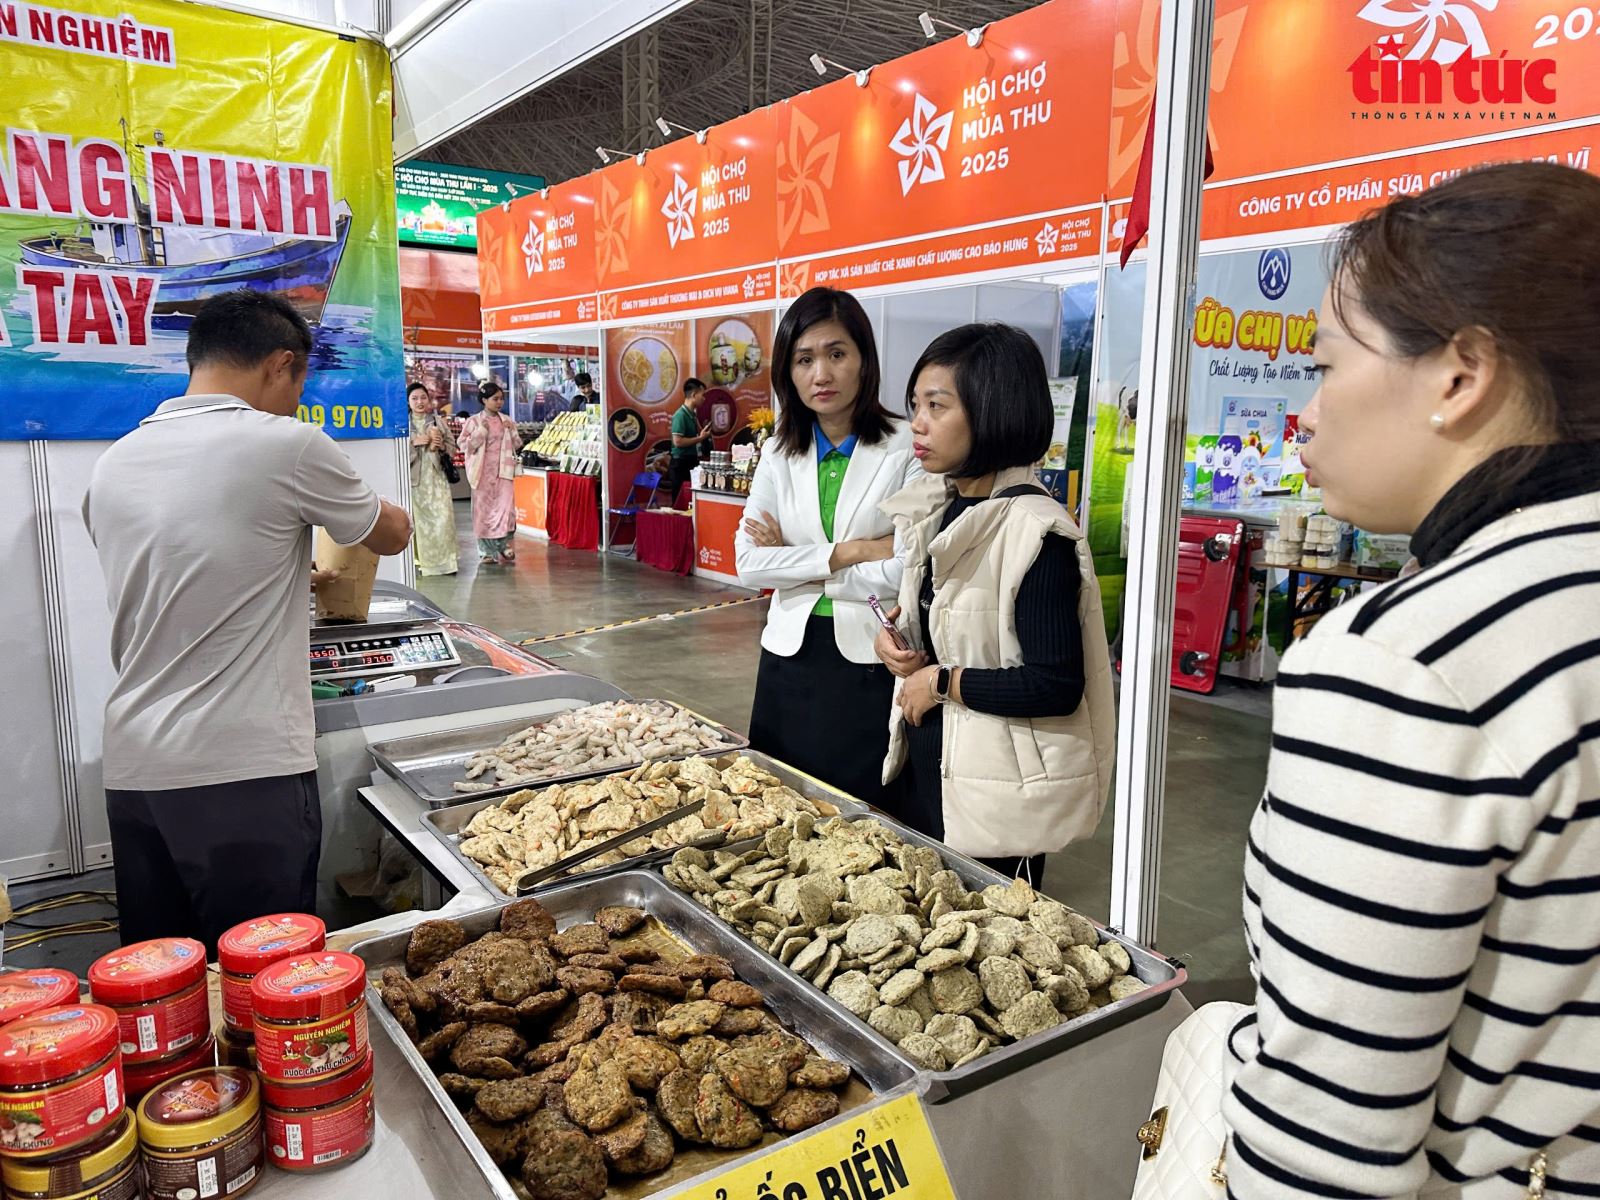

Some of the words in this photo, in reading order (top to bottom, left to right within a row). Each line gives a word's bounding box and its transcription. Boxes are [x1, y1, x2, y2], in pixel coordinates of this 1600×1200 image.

[29, 9, 170, 62] NGHIÊM
[1532, 6, 1600, 49] 20
[963, 79, 996, 111] HỘI
[1001, 60, 1047, 95] CHỢ
[962, 110, 1003, 144] MÙA
[1010, 100, 1051, 131] THU
[702, 165, 720, 189] HỘI
[722, 156, 747, 180] CHỢ
[961, 146, 1009, 178] 2025
[0, 133, 130, 220] NG
[151, 151, 332, 236] NINH
[416, 175, 429, 185] CHỢ
[1239, 195, 1281, 218] CÔNG
[1284, 191, 1304, 211] TY
[1309, 181, 1331, 207] CỔ
[1335, 176, 1382, 202] PHẦN
[1388, 172, 1424, 195] SỮA
[703, 188, 725, 213] MÙA
[728, 184, 750, 205] THU
[560, 210, 575, 231] CHỢ
[703, 218, 730, 238] 2025
[1061, 231, 1076, 241] MÙA
[1077, 229, 1091, 238] THU
[1062, 219, 1073, 230] HỘI
[1075, 217, 1090, 228] CHỢ
[547, 236, 563, 252] MÙA
[563, 234, 578, 248] THU
[1061, 243, 1077, 252] 2025
[548, 257, 565, 271] 2025
[829, 268, 839, 281] TÁC
[864, 258, 880, 274] XUẤT
[896, 256, 916, 269] XANH
[917, 250, 936, 266] CHẤT
[937, 248, 963, 264] LƯỢNG
[965, 244, 982, 259] CAO
[22, 269, 154, 346] TAY
[1236, 310, 1283, 361] CHỊ
[1209, 356, 1230, 377] Chất
[1233, 360, 1259, 384] Lượng
[1263, 363, 1277, 383] Tạo
[1280, 362, 1301, 380] Niềm
[332, 405, 384, 429] 9709
[293, 1028, 325, 1041] NGUYÊN
[325, 1018, 352, 1037] NGHIÊM
[816, 1128, 910, 1200] BIỂN
